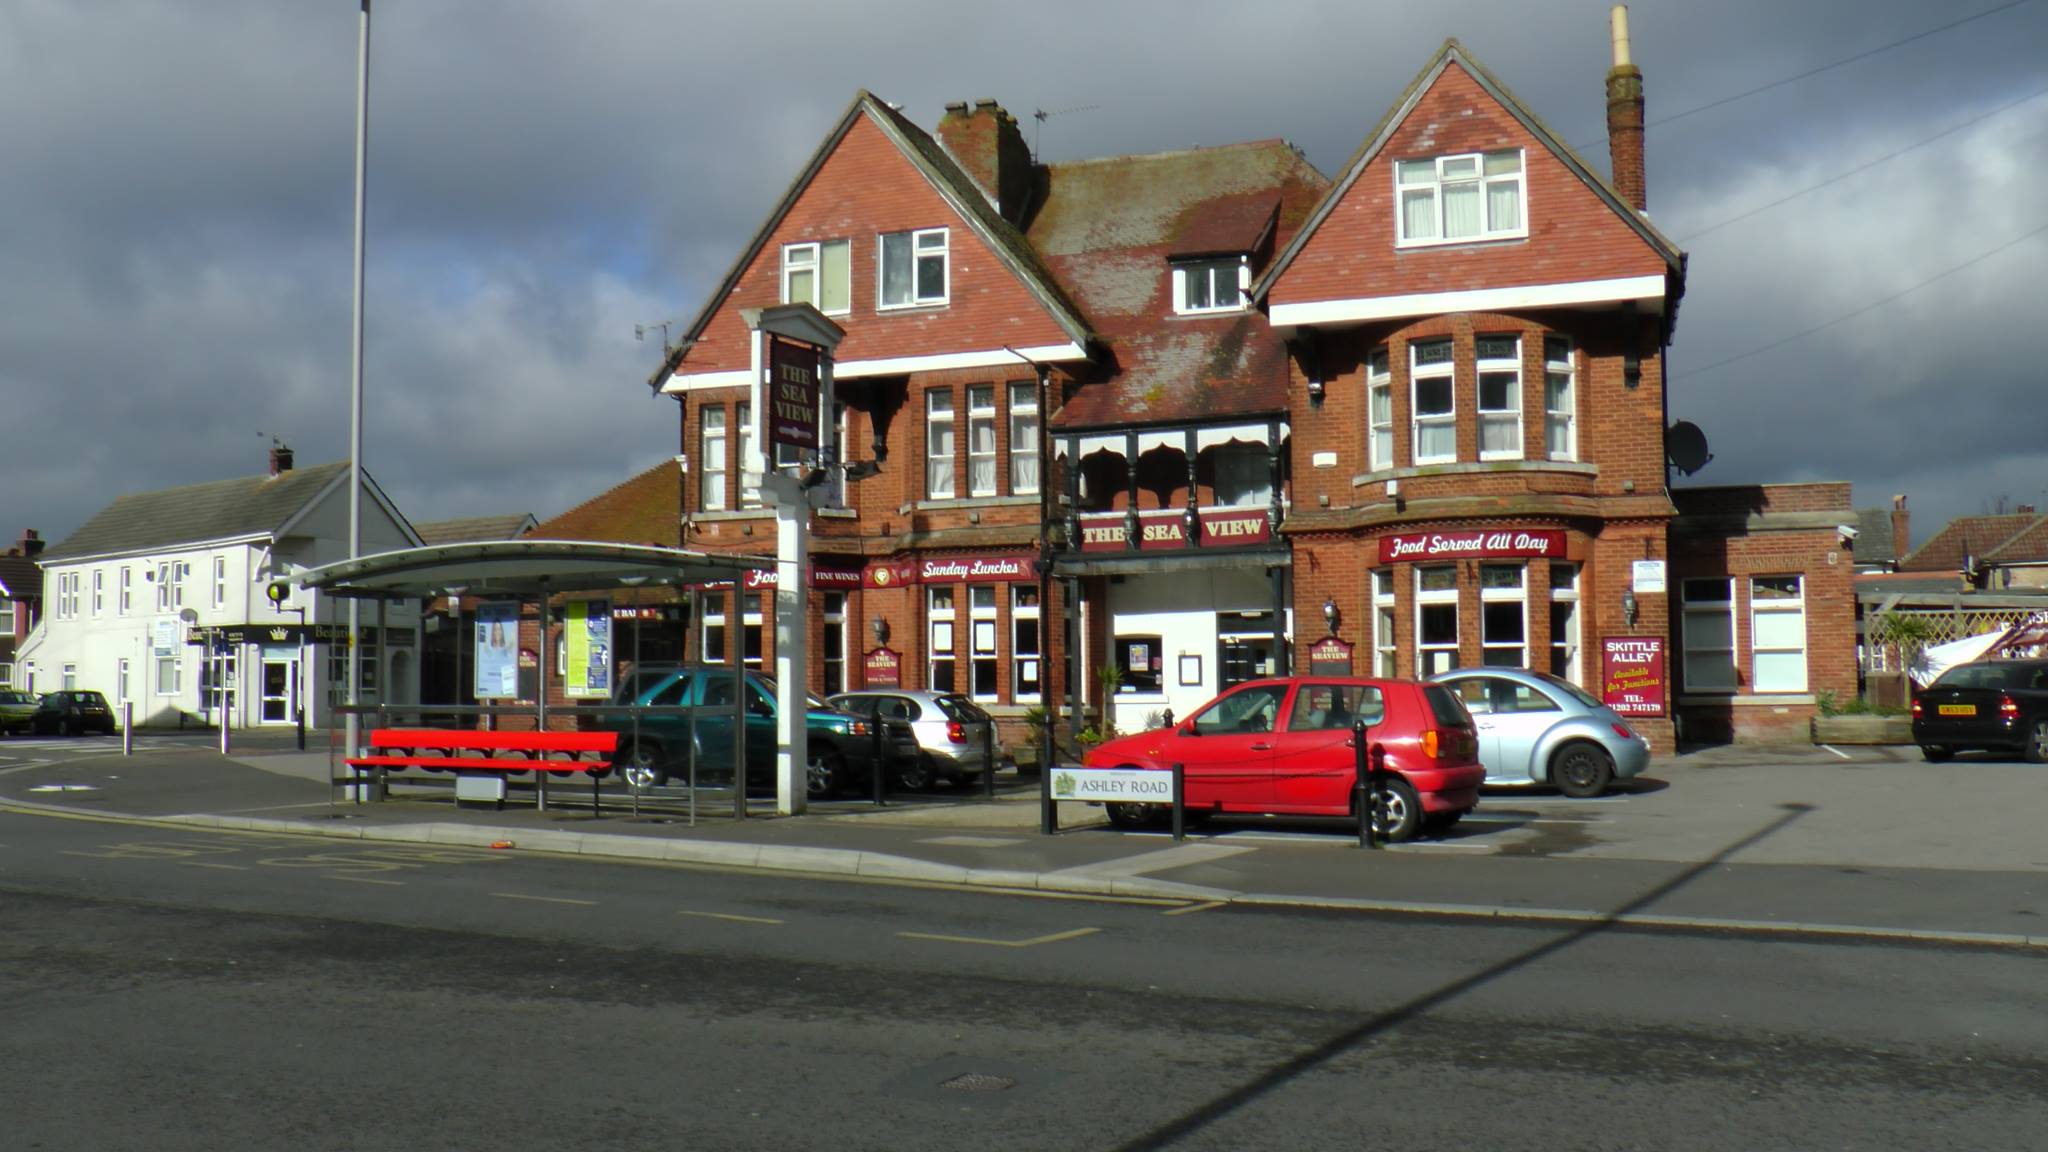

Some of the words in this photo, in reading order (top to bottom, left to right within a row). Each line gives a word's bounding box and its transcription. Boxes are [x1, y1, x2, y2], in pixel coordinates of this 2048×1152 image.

[780, 363, 811, 385] THE
[781, 384, 808, 404] SEA
[775, 401, 814, 424] VIEW
[1083, 526, 1125, 543] THE
[1142, 524, 1182, 541] SEA
[1205, 518, 1264, 537] VIEW
[1390, 536, 1427, 557] Food
[1428, 533, 1484, 554] Served
[1486, 532, 1512, 550] All
[1514, 533, 1548, 554] Day
[815, 571, 834, 580] FINE
[834, 572, 860, 581] WINES
[923, 561, 968, 579] Sunday
[970, 560, 1018, 575] Lunches
[1320, 645, 1340, 653] THE
[1606, 642, 1660, 652] SKITTLE
[1612, 653, 1654, 663] ALLEY
[1613, 667, 1649, 679] Available
[1607, 682, 1620, 693] for
[1621, 678, 1660, 690] Functions
[1623, 694, 1644, 703] TEL:
[1081, 780, 1126, 793] ASHLEY
[1131, 781, 1168, 793] ROAD
